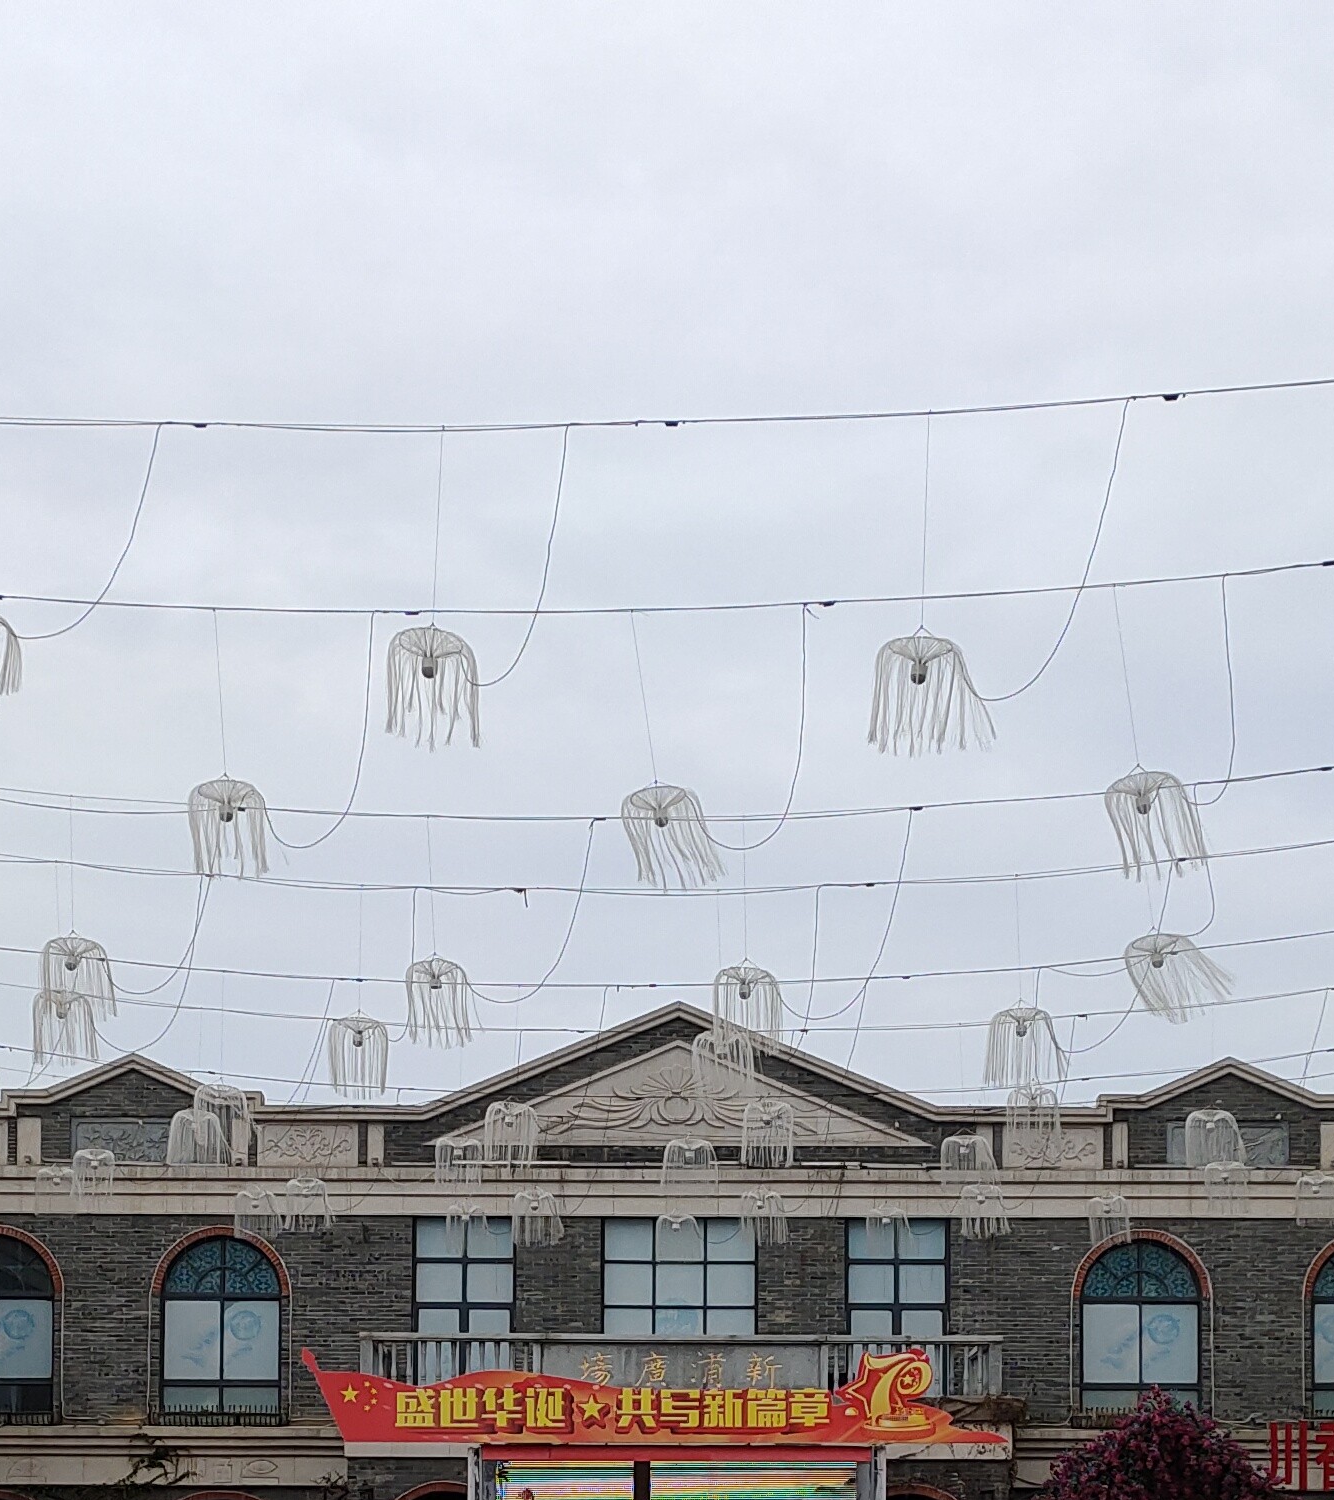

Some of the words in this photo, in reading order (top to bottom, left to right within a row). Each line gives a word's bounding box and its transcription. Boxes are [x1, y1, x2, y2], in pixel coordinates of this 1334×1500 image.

[395, 1387, 569, 1429] 盛世华诞
[617, 1387, 831, 1429] 共写新篇章
